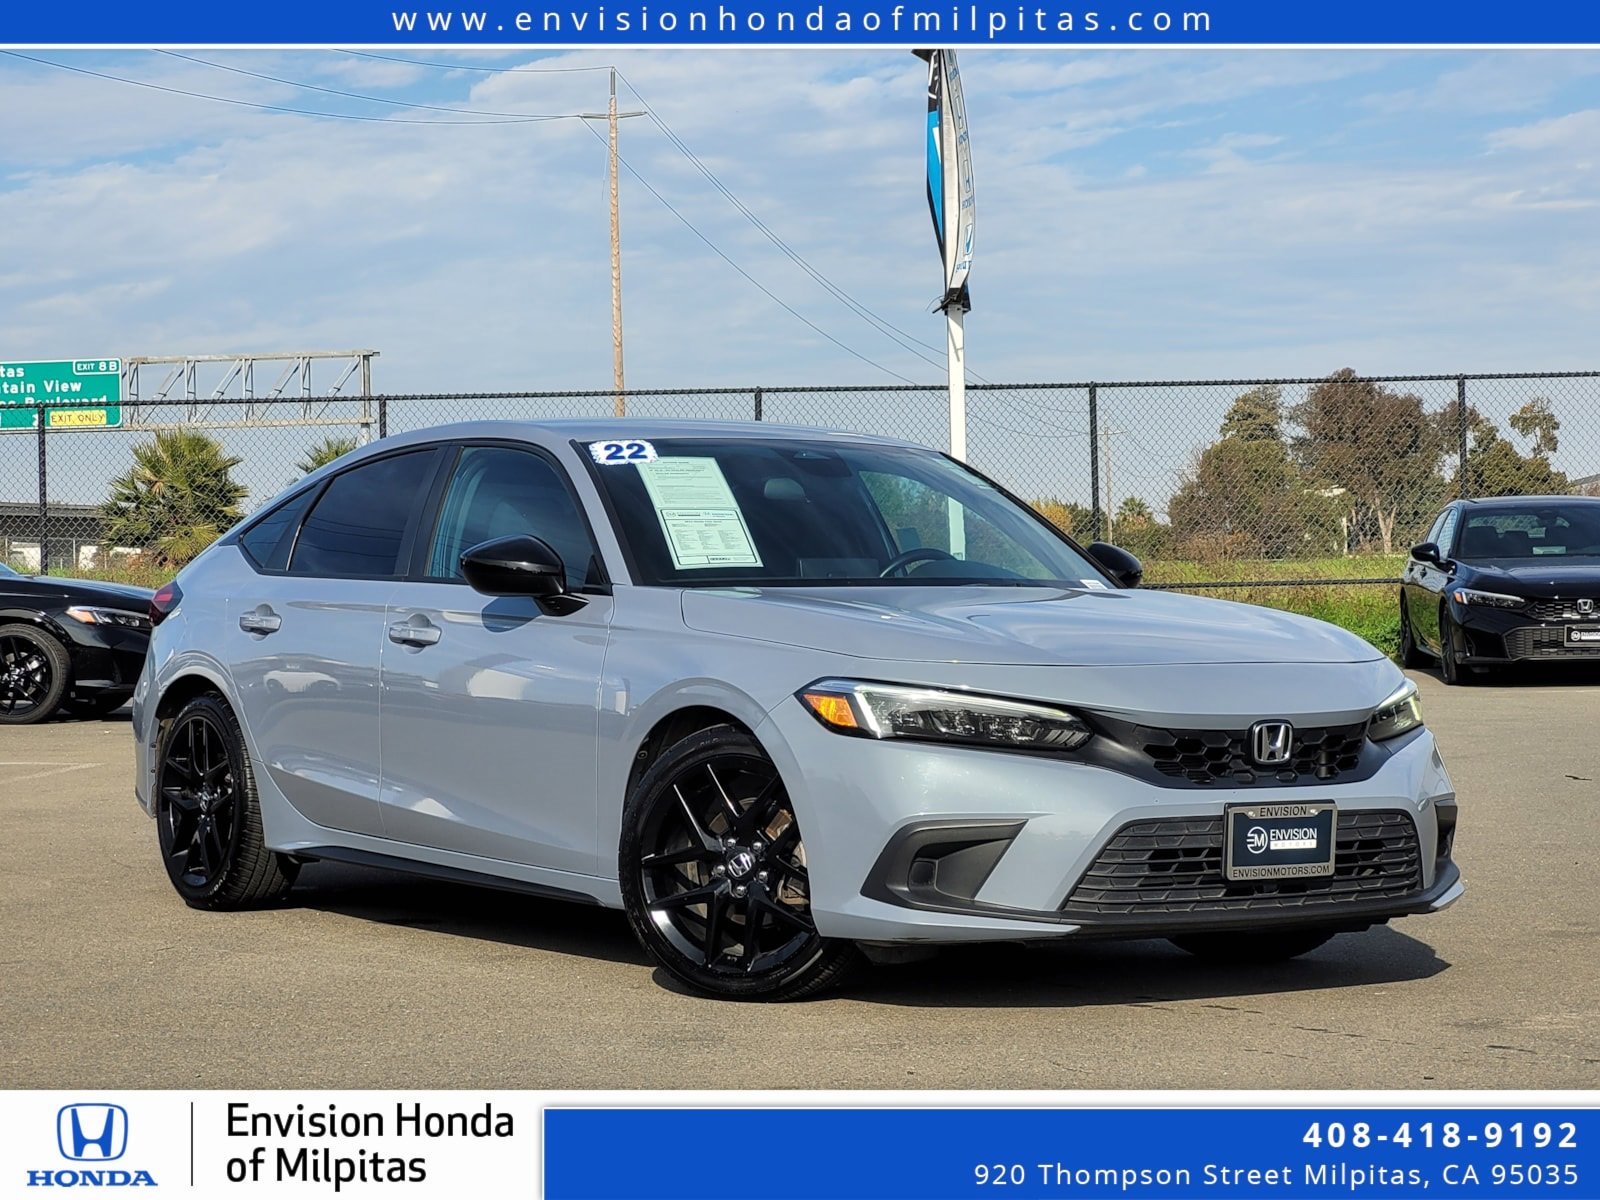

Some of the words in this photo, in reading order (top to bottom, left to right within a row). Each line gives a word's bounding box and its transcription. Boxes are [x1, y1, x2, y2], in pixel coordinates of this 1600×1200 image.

[76, 363, 95, 371] EXIT
[43, 380, 82, 393] View
[51, 415, 73, 423] EXIT
[77, 413, 104, 422] ONLY
[604, 443, 648, 460] 22
[1260, 806, 1307, 816] ENVISION
[1270, 828, 1317, 840] ENVISION
[1232, 865, 1330, 878] ENVISIONMOTORS.COM
